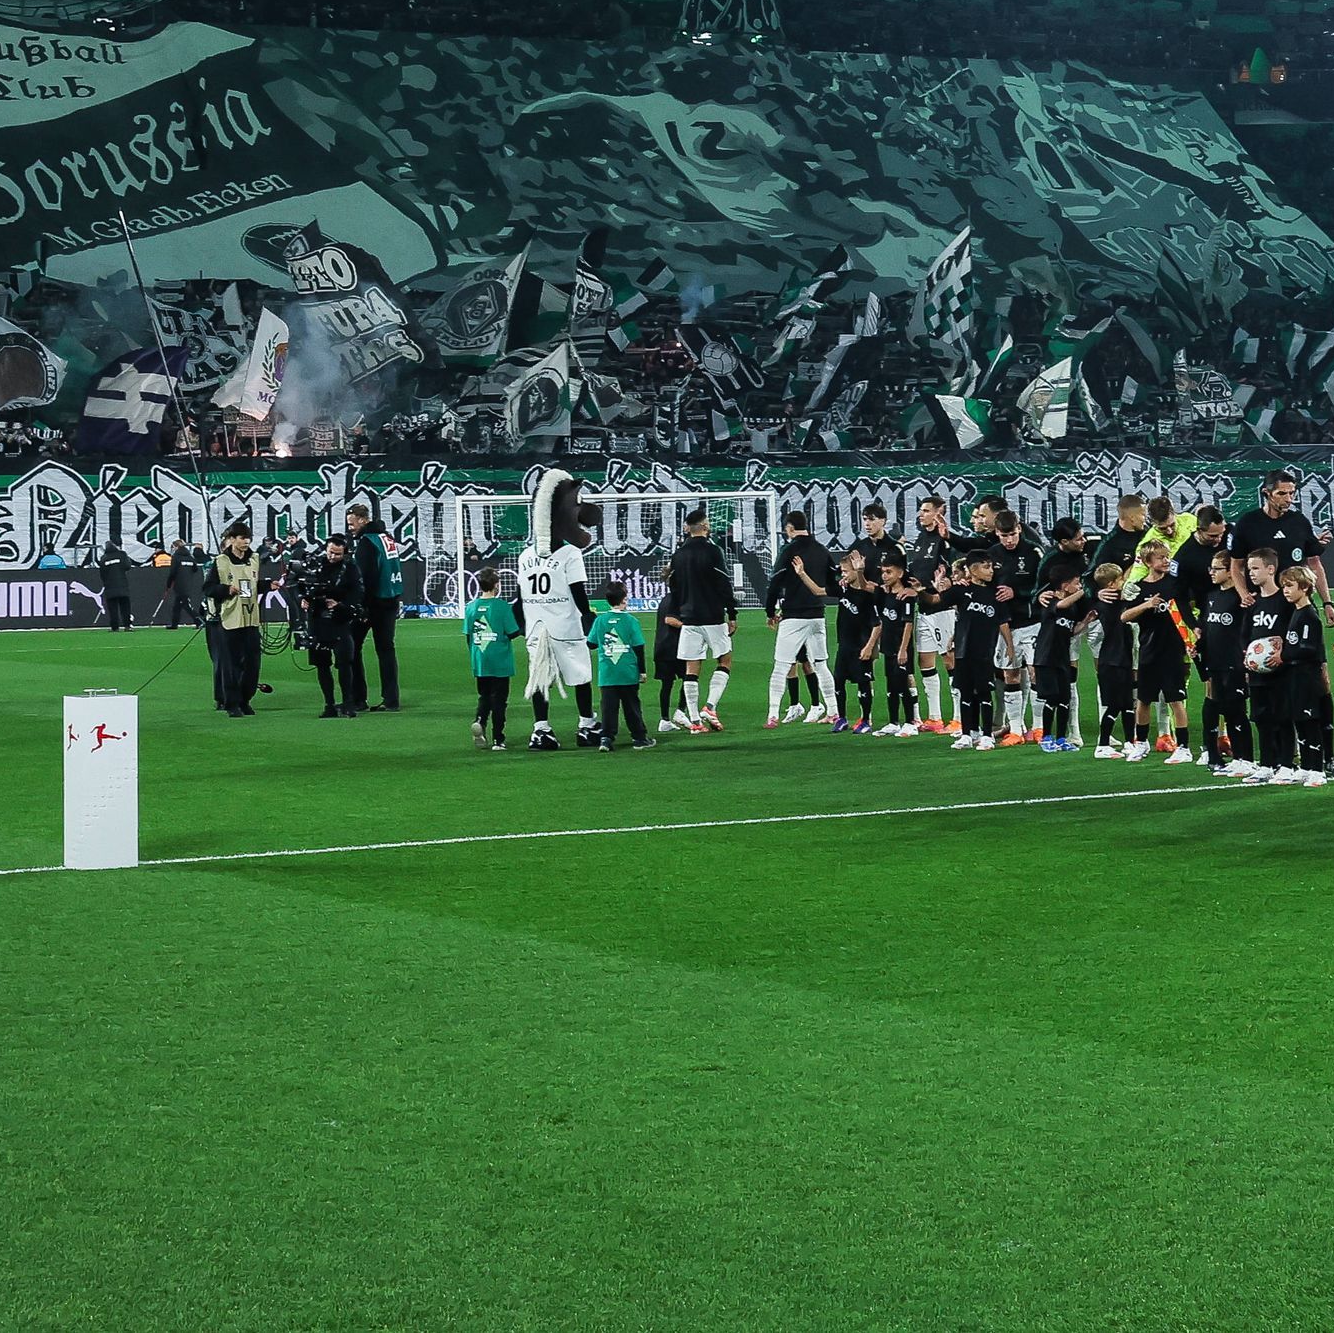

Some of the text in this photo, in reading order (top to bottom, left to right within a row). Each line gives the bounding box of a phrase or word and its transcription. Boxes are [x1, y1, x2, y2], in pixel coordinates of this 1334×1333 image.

[390, 572, 402, 584] 44
[527, 572, 552, 595] 10
[967, 601, 987, 611] AOK
[1253, 610, 1279, 630] sky
[935, 628, 941, 642] 6
